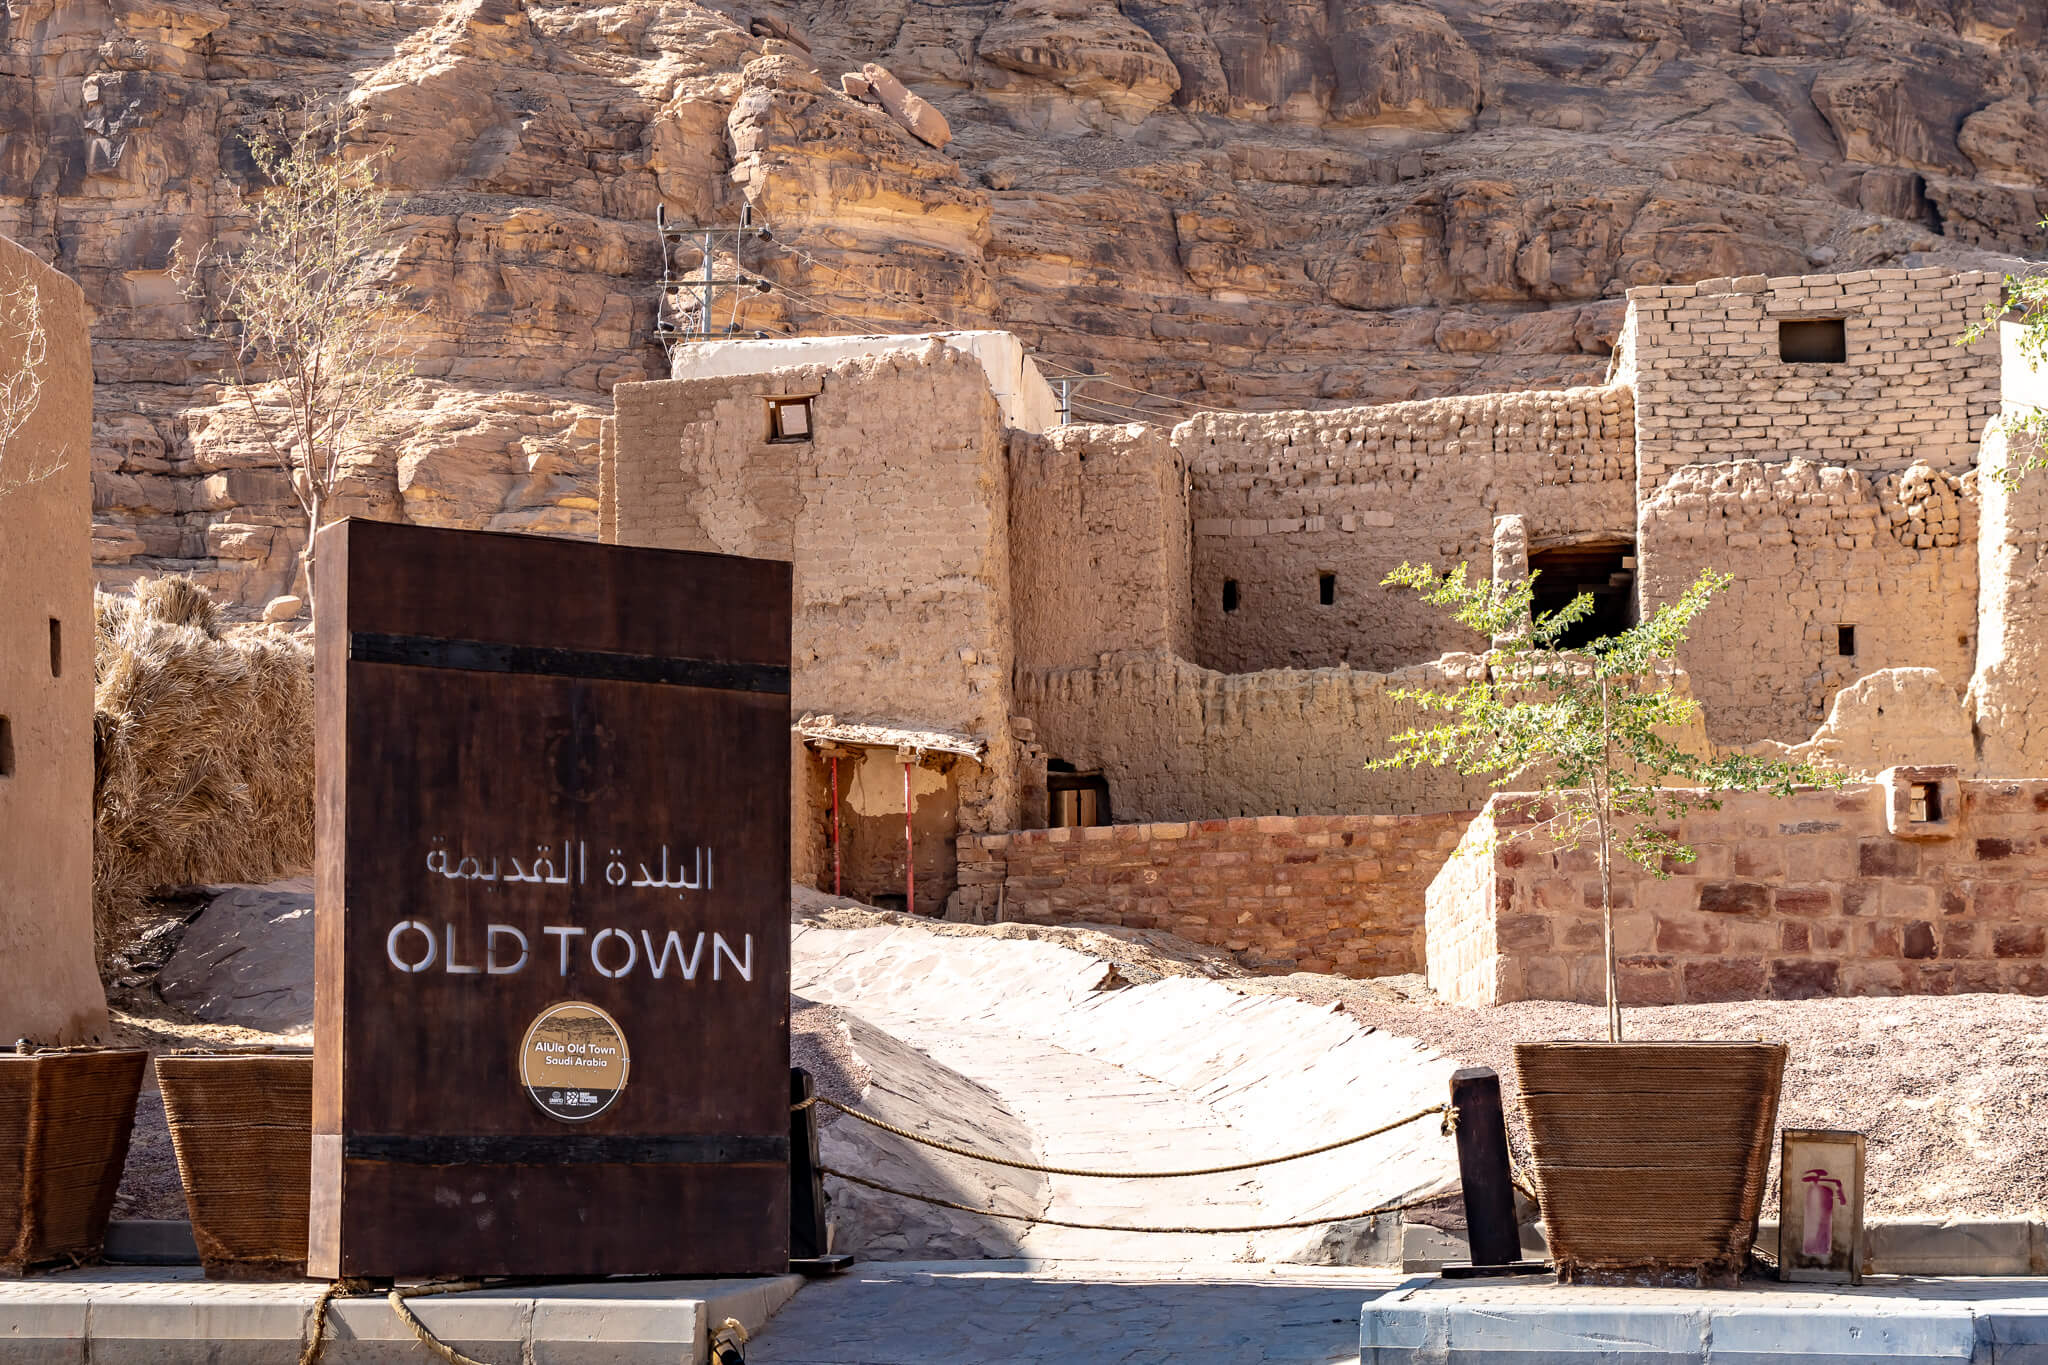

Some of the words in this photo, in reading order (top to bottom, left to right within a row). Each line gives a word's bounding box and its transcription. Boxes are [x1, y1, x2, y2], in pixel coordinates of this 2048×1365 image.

[426, 835, 585, 893] القديمة
[605, 843, 713, 900] البلدة
[386, 920, 530, 975] OLD
[543, 925, 753, 982] TOWN
[535, 1041, 565, 1053] AlUla
[567, 1043, 586, 1054] Old
[588, 1044, 616, 1055] Town
[545, 1055, 573, 1066] Saudi
[575, 1057, 607, 1067] Arabia
